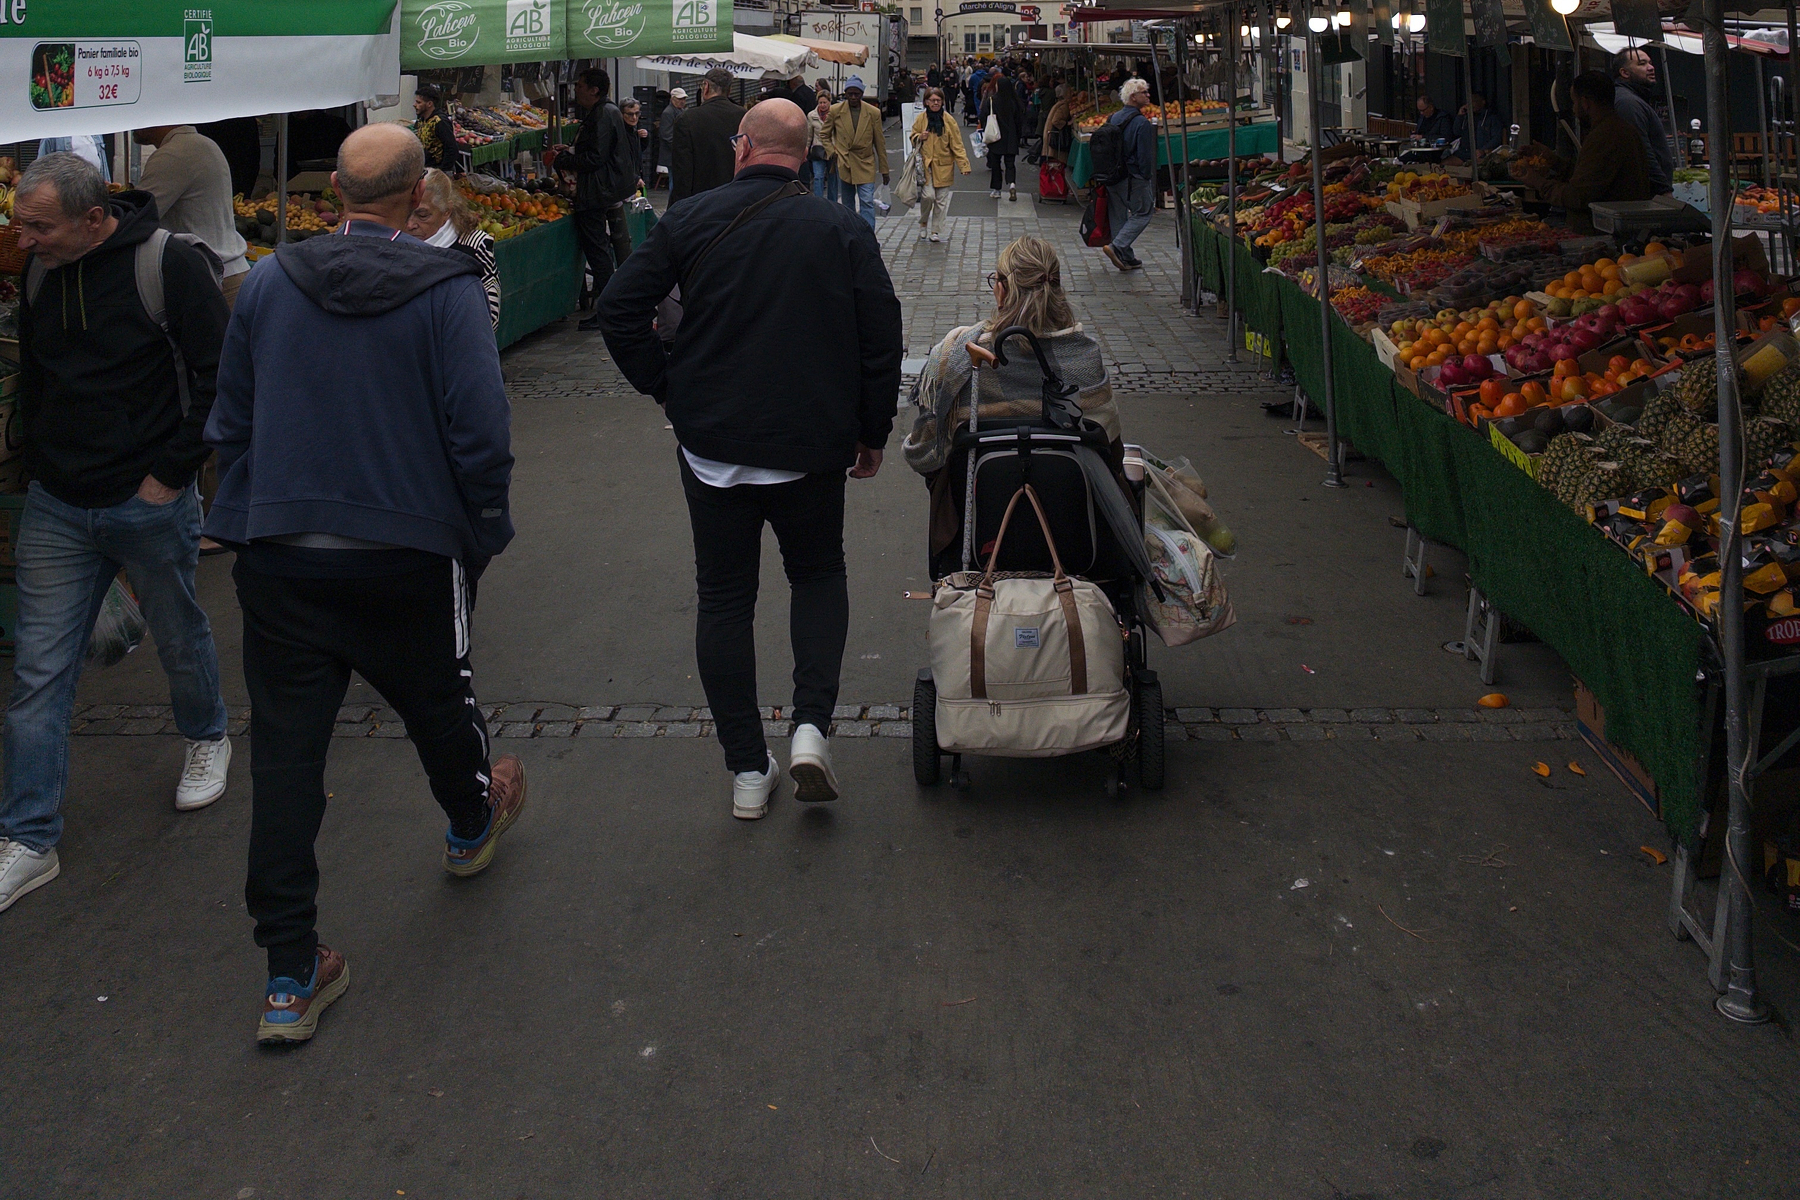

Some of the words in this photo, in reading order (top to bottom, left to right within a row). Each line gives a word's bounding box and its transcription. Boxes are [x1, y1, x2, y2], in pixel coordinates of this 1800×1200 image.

[676, 0, 710, 25] AB
[961, 2, 987, 11] Marché
[988, 2, 1015, 11] d'Aligre
[510, 9, 544, 35] AB
[583, 1, 643, 31] Lahcen
[421, 12, 477, 42] Lahcen
[614, 27, 633, 37] Bio
[187, 33, 208, 60] AB
[448, 38, 467, 48] Bio
[506, 42, 551, 50] BIOLOGIQUE
[78, 47, 99, 59] Panier
[100, 47, 128, 58] familiale
[128, 47, 139, 58] bio
[87, 65, 93, 77] 6
[94, 65, 103, 79] kg
[104, 65, 109, 76] à
[111, 64, 120, 77] 7,5
[121, 64, 130, 78] kg
[686, 59, 701, 69] de
[98, 84, 118, 100] 32€
